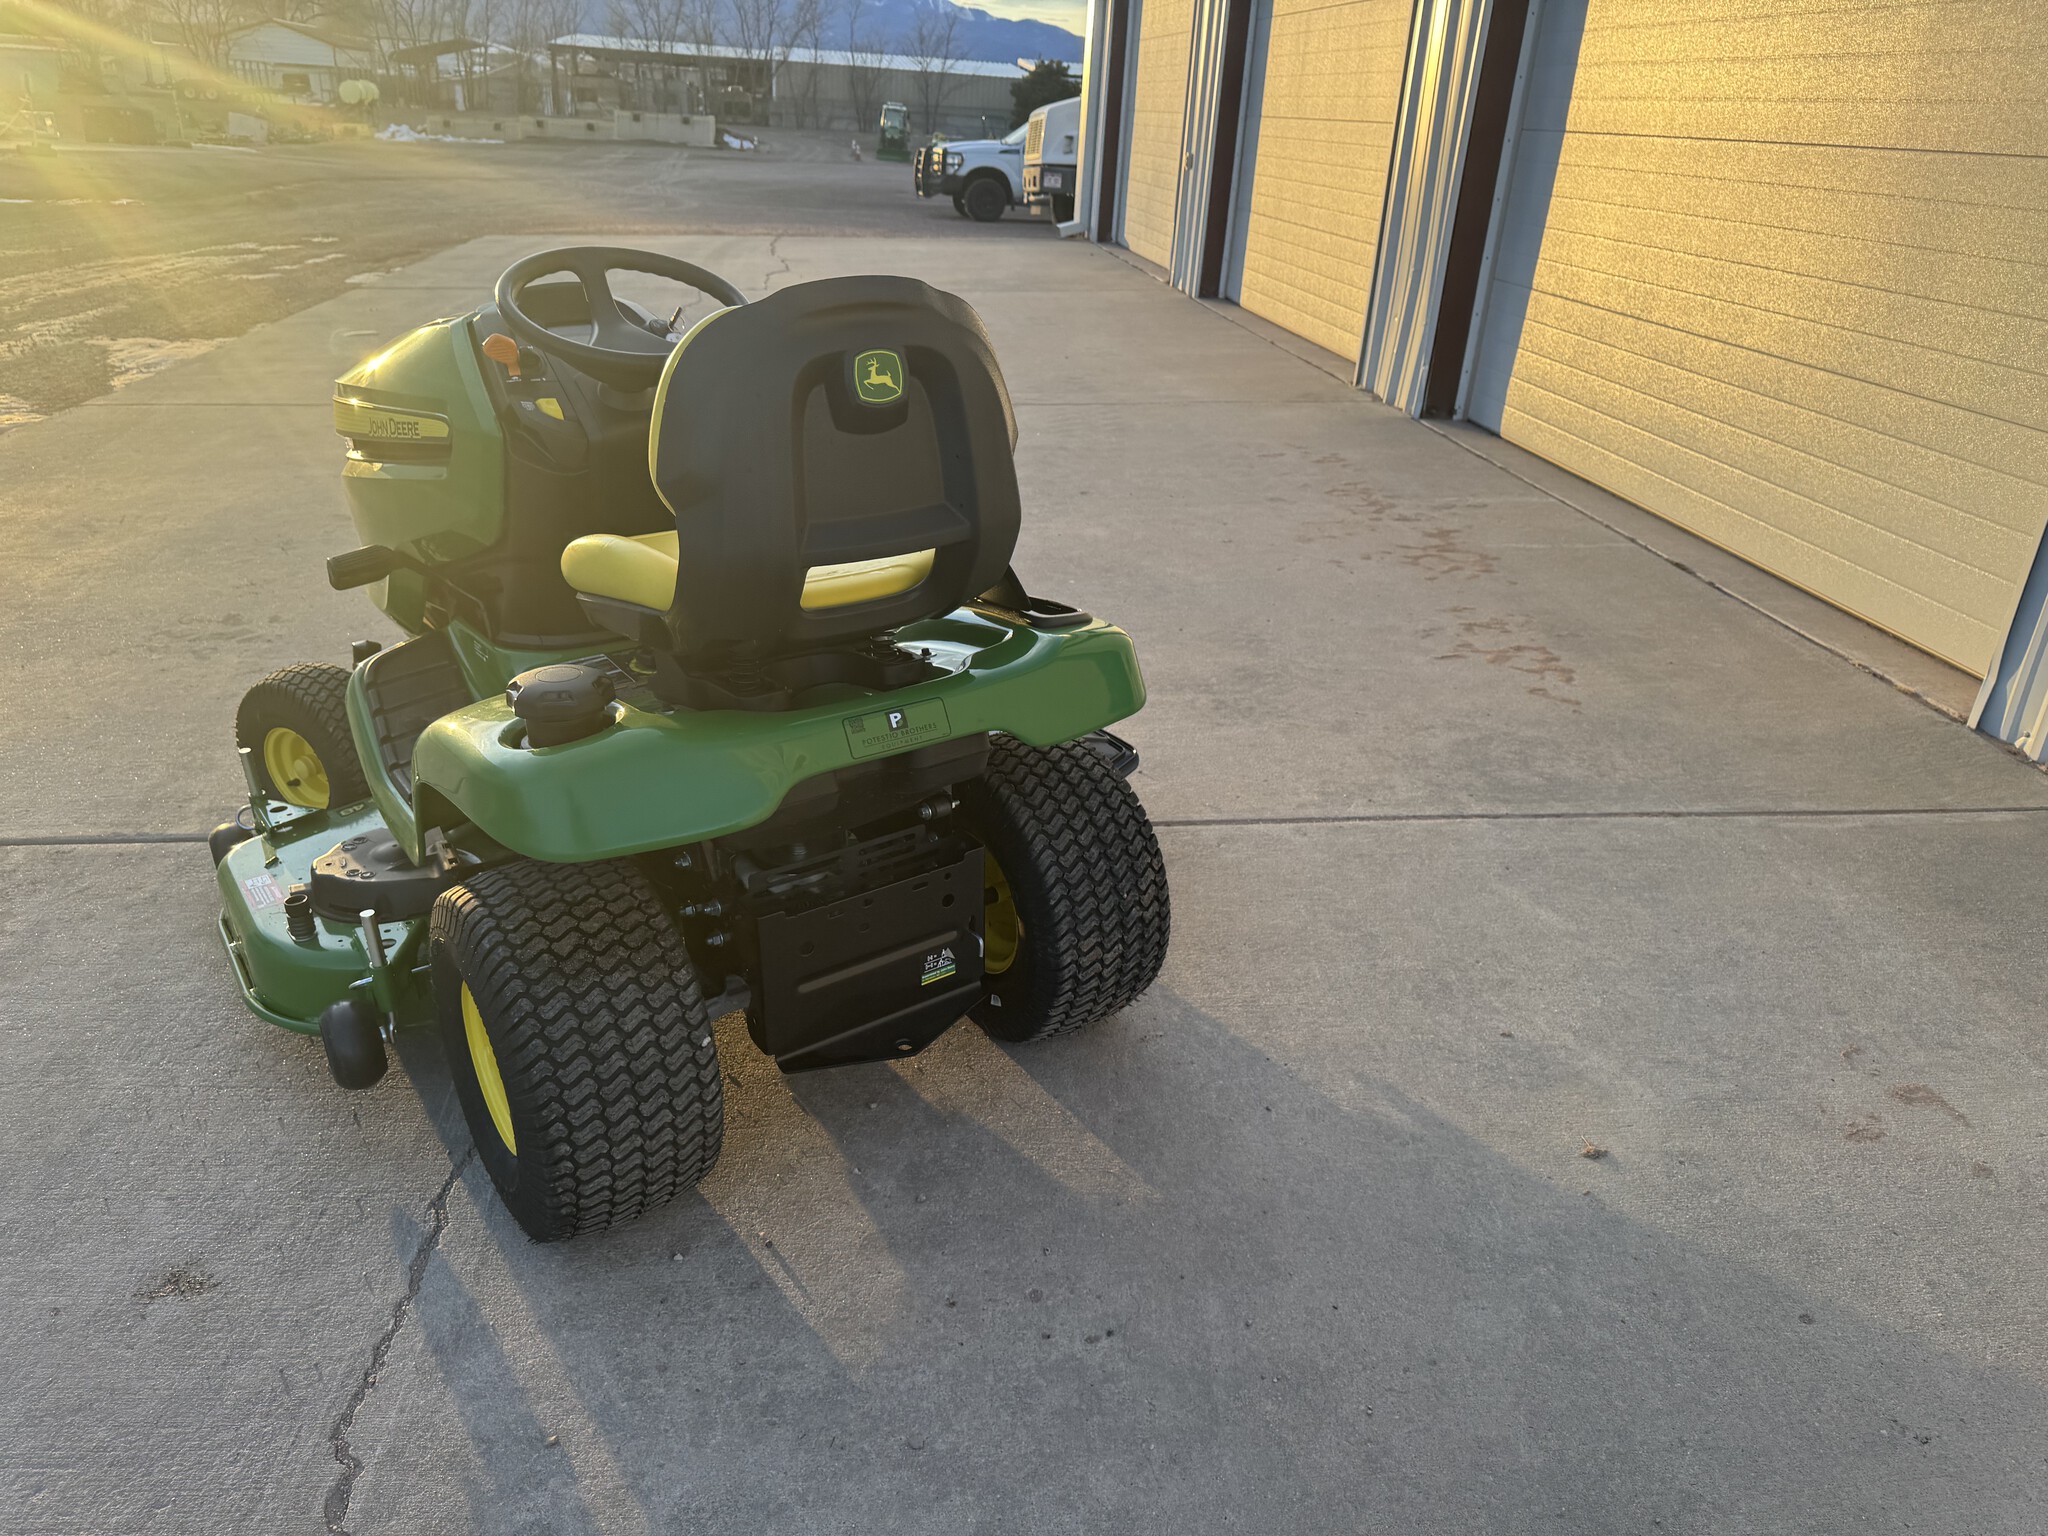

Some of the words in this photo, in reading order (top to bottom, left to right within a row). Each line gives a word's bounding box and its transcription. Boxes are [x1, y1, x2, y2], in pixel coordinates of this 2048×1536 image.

[369, 417, 389, 436] JOHN
[389, 418, 420, 437] DEERE
[862, 731, 899, 746] POTESTIO
[900, 722, 937, 737] BROTHERS
